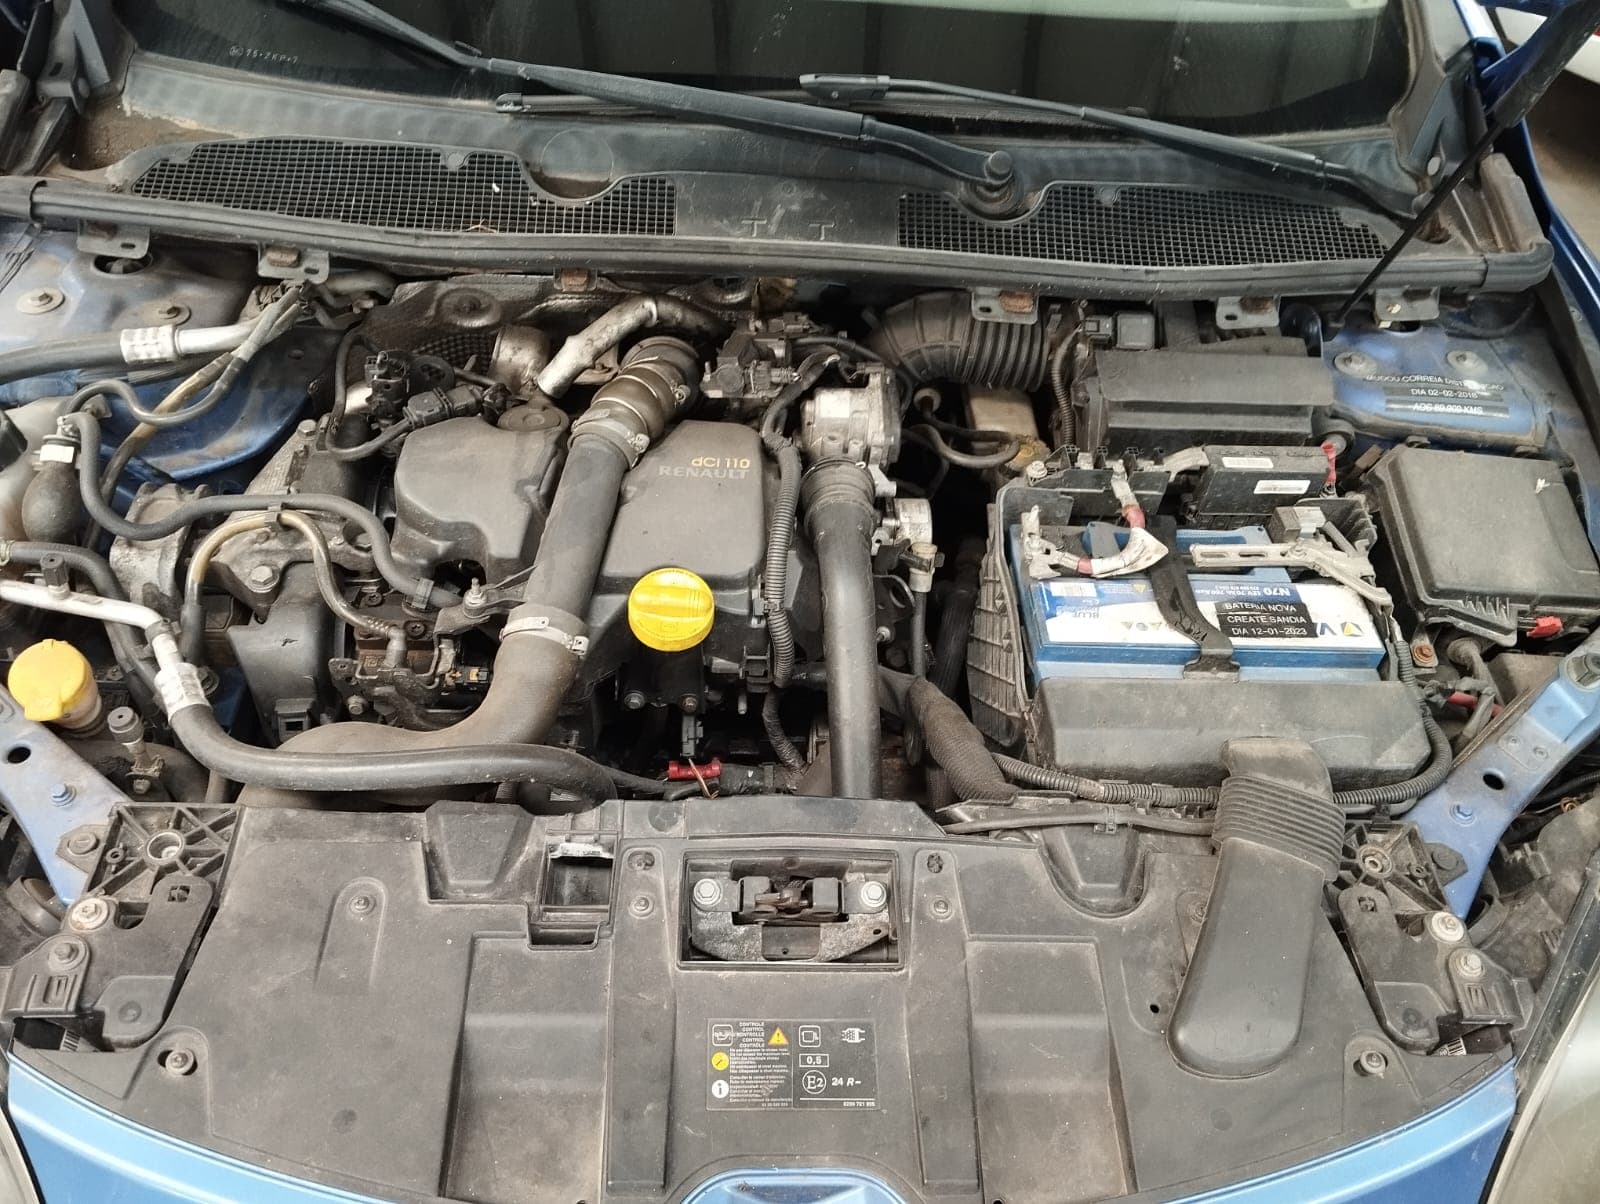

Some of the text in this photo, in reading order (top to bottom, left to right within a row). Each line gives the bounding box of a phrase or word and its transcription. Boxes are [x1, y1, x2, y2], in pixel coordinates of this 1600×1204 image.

[1402, 374, 1443, 383] CORREIA
[1410, 388, 1427, 396] DIA
[725, 457, 750, 469] 110
[659, 465, 750, 479] RENAULT
[1225, 602, 1297, 612] BATERIA NOVA
[1269, 616, 1308, 624] SANDIA
[1232, 627, 1249, 636] DIA
[1251, 627, 1308, 636] 12-01-2023
[831, 1077, 843, 1086] 24
